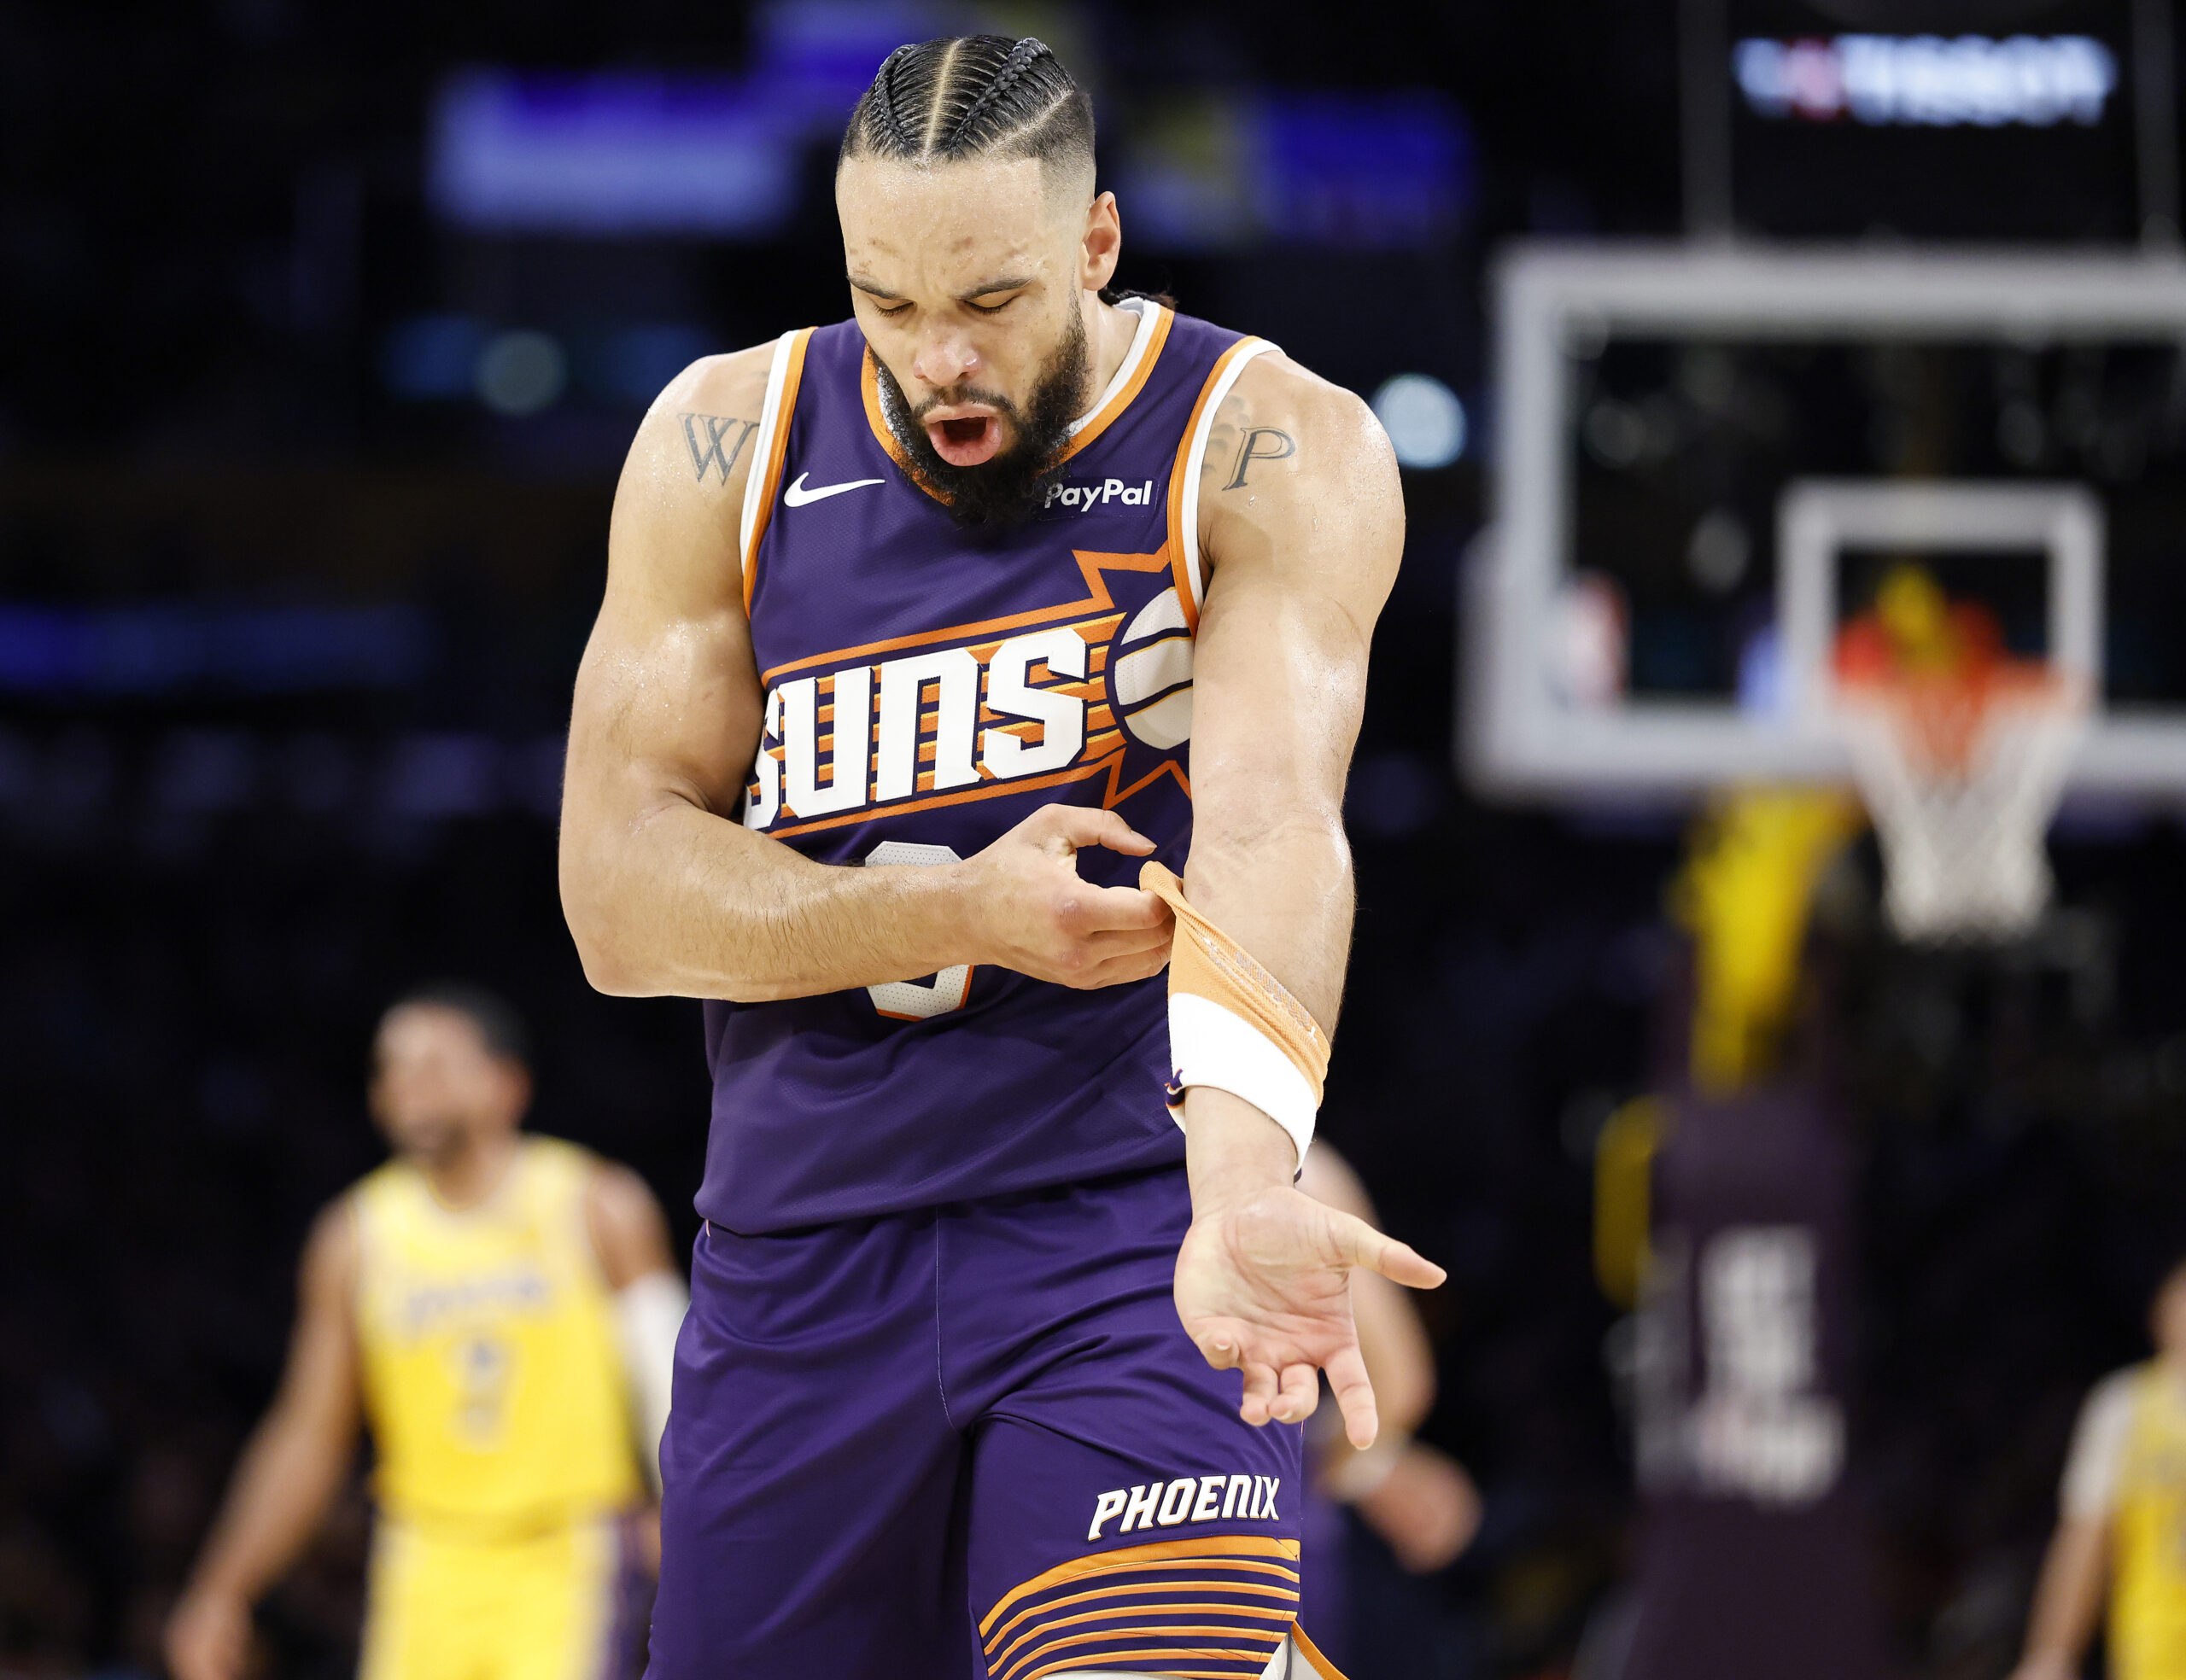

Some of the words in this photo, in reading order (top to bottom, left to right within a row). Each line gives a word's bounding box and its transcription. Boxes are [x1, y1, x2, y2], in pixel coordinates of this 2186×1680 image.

[676, 412, 761, 486] W
[1221, 426, 1295, 491] P
[1044, 478, 1153, 512] PayPal
[1087, 1473, 1280, 1542] PHOENIX
